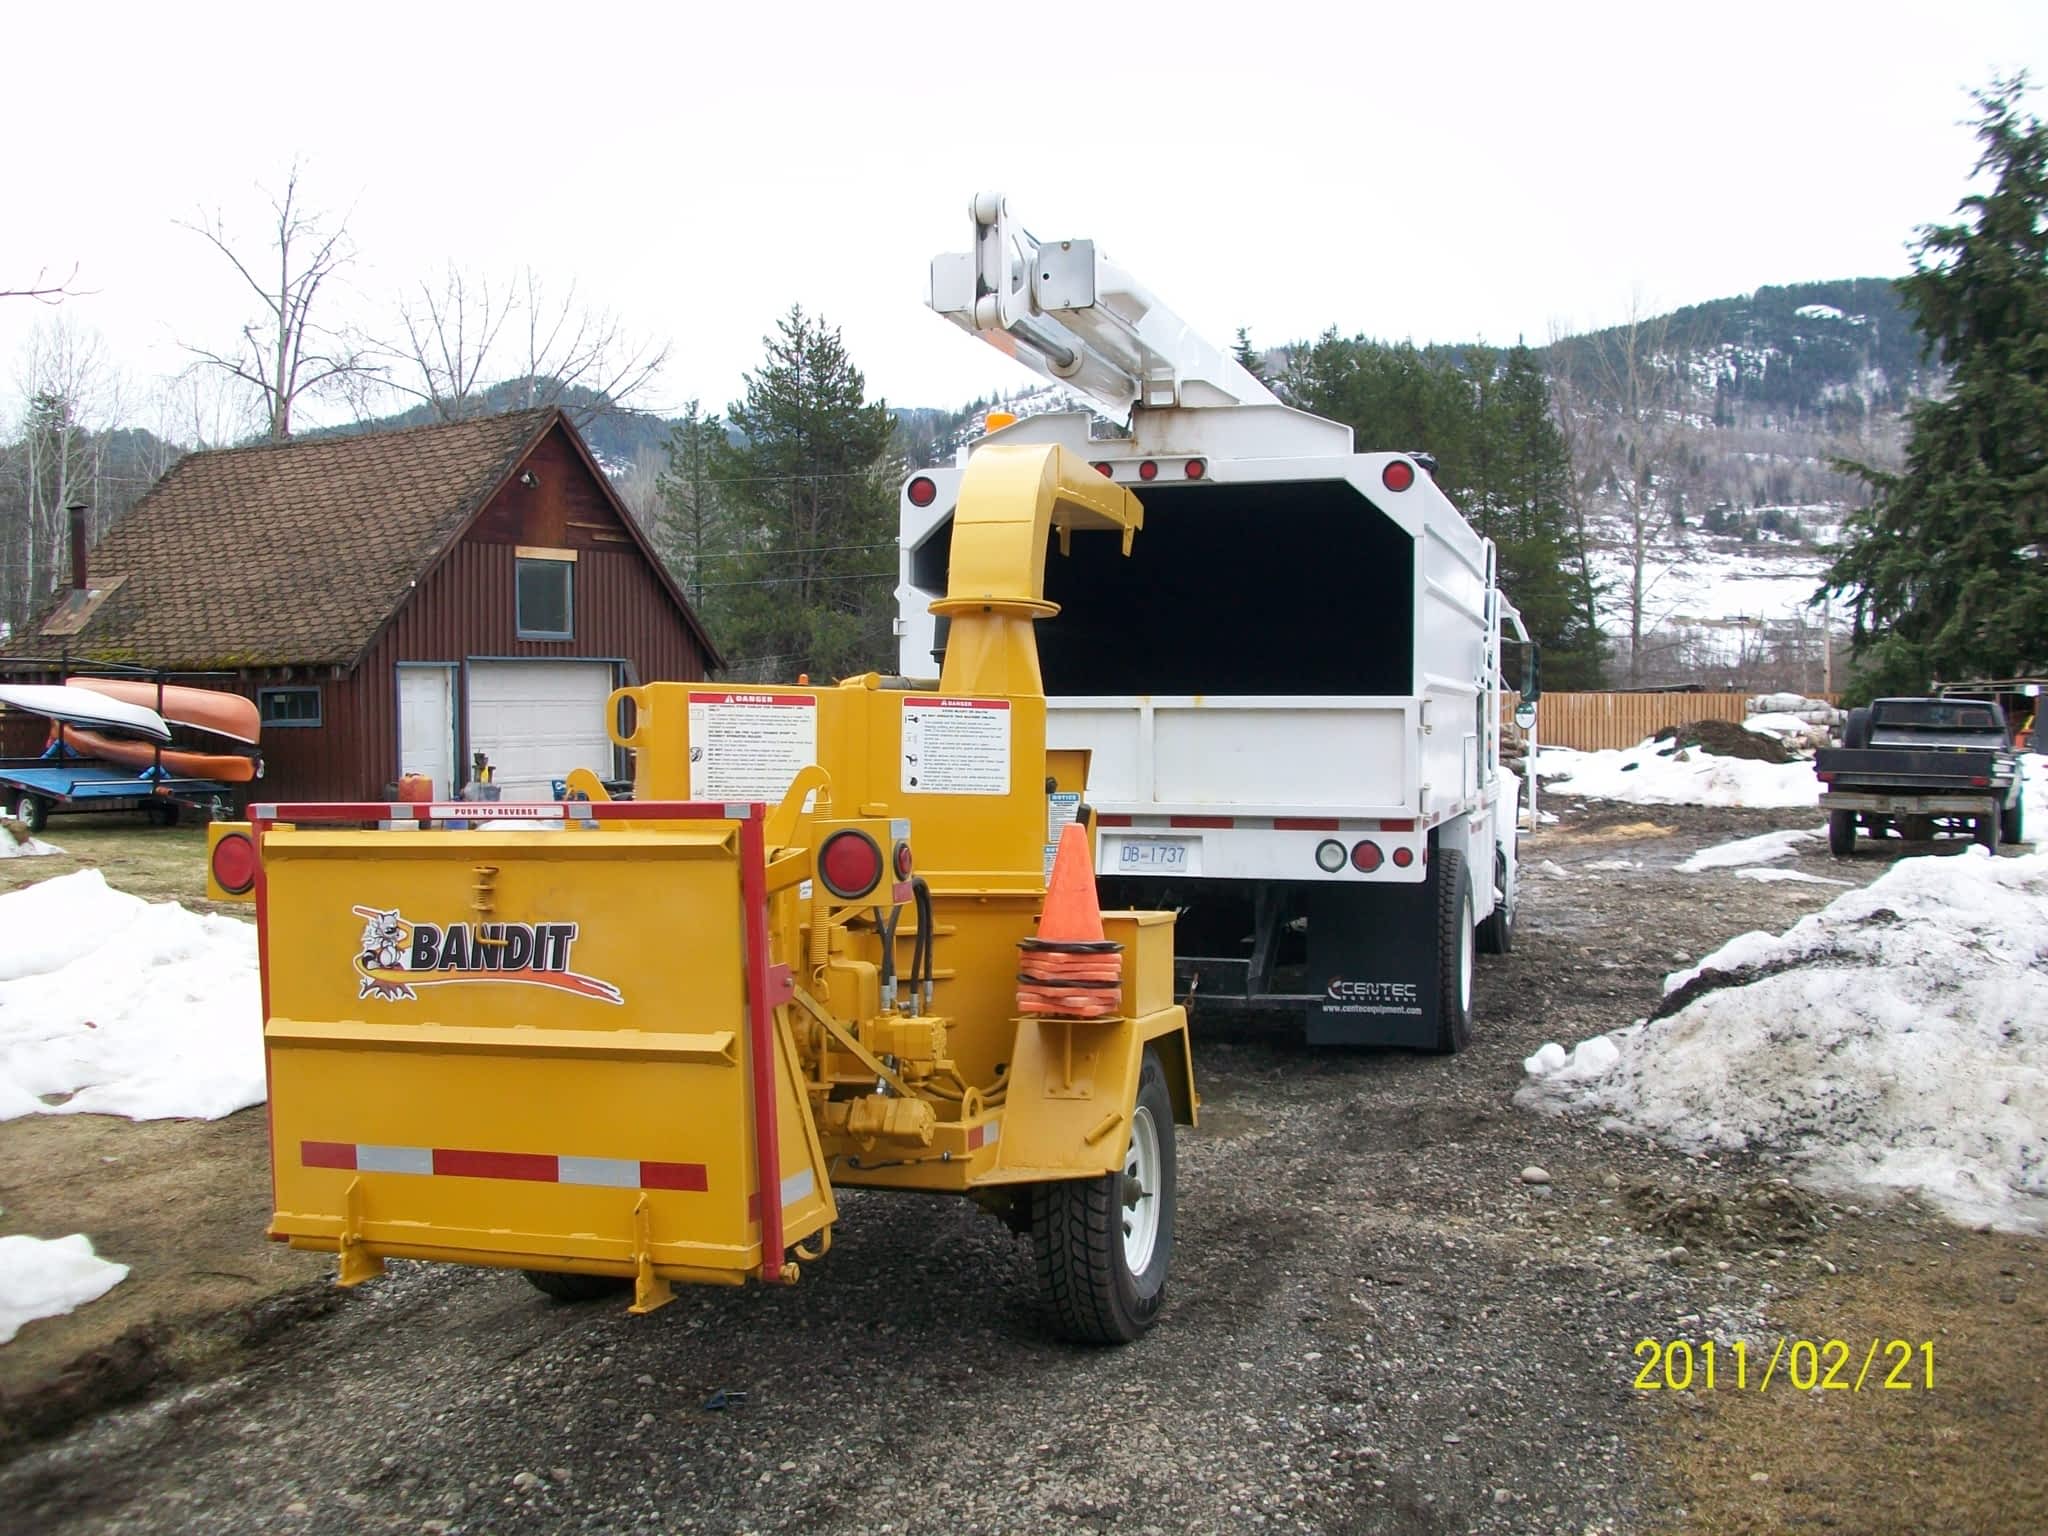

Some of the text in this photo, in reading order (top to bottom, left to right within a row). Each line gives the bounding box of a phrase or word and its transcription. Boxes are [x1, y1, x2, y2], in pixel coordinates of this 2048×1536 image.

[735, 695, 774, 703] DANGER
[497, 808, 539, 816] REVERSE
[409, 922, 577, 972] BANDIT
[1341, 982, 1417, 996] CENTEC
